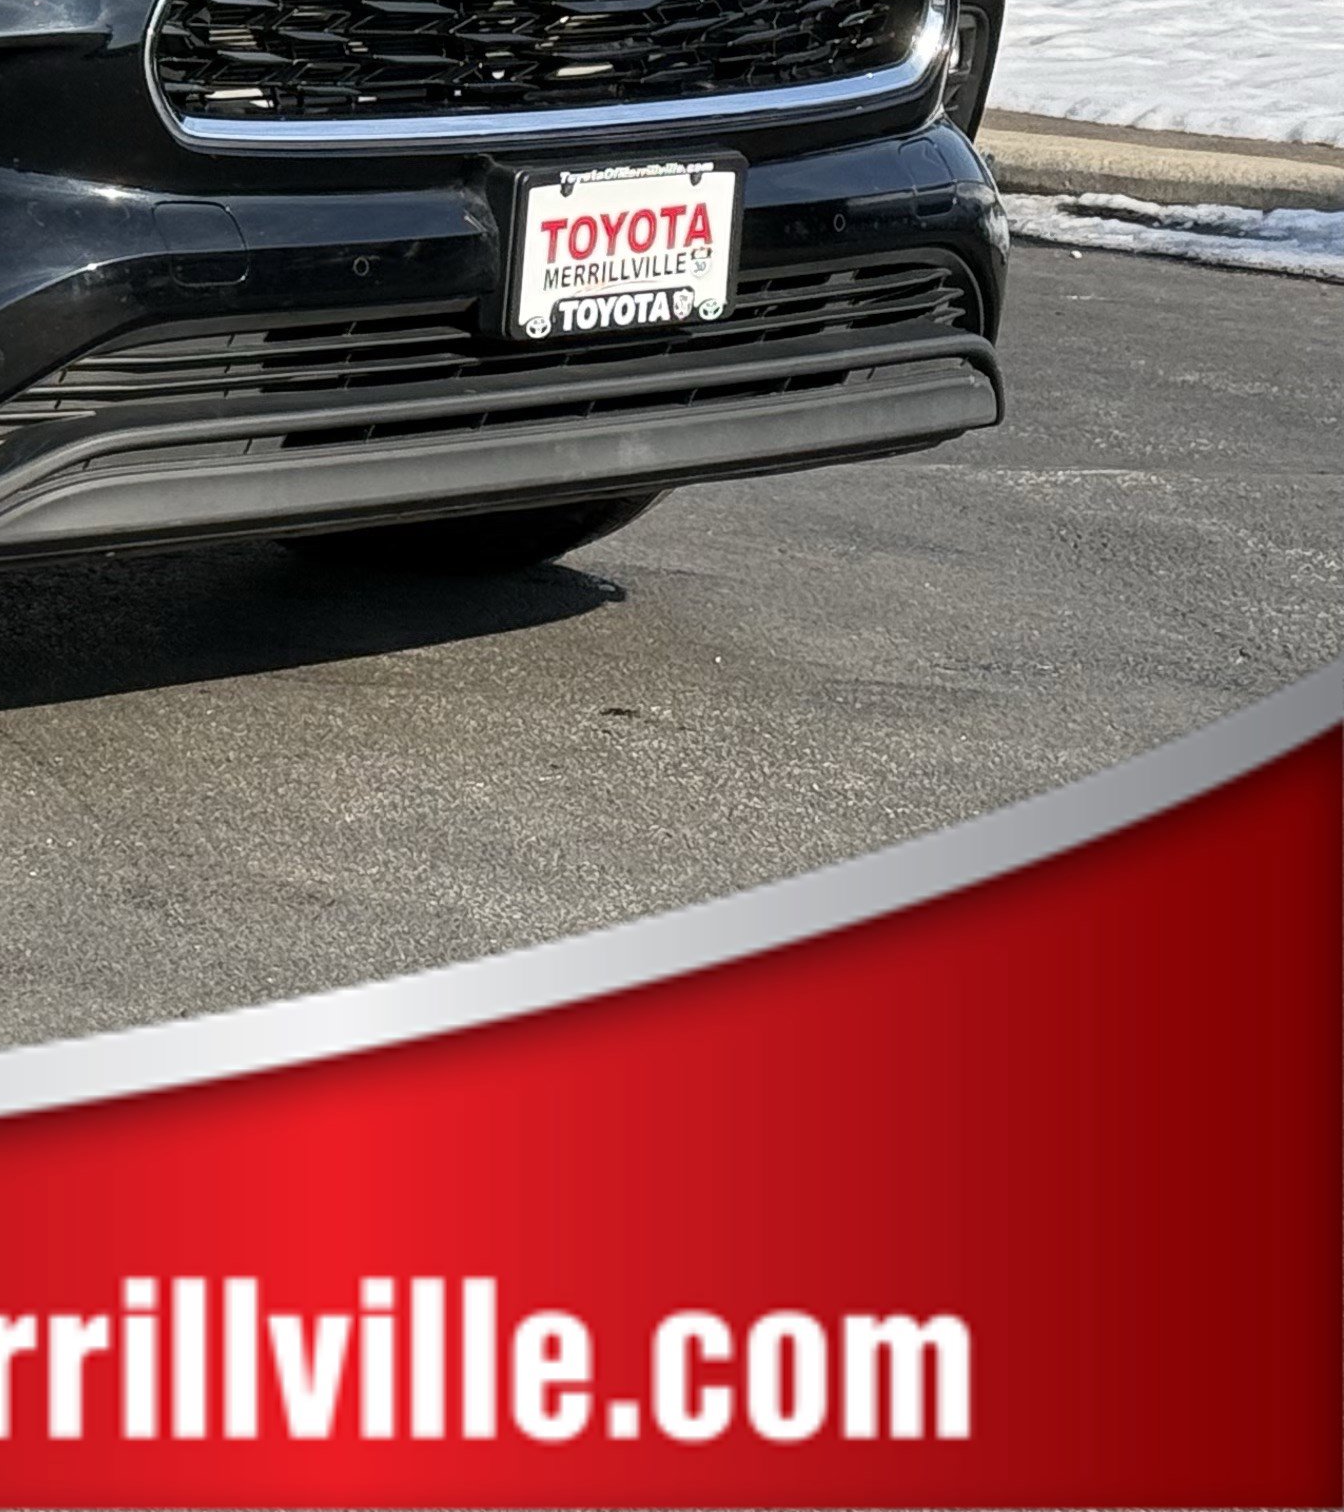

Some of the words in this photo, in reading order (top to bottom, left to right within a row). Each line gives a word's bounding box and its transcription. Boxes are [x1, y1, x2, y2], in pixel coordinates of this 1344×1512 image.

[540, 202, 714, 264] TOYOTA
[543, 251, 687, 292] MERRILLVILLE
[559, 288, 671, 332] TOYOTA
